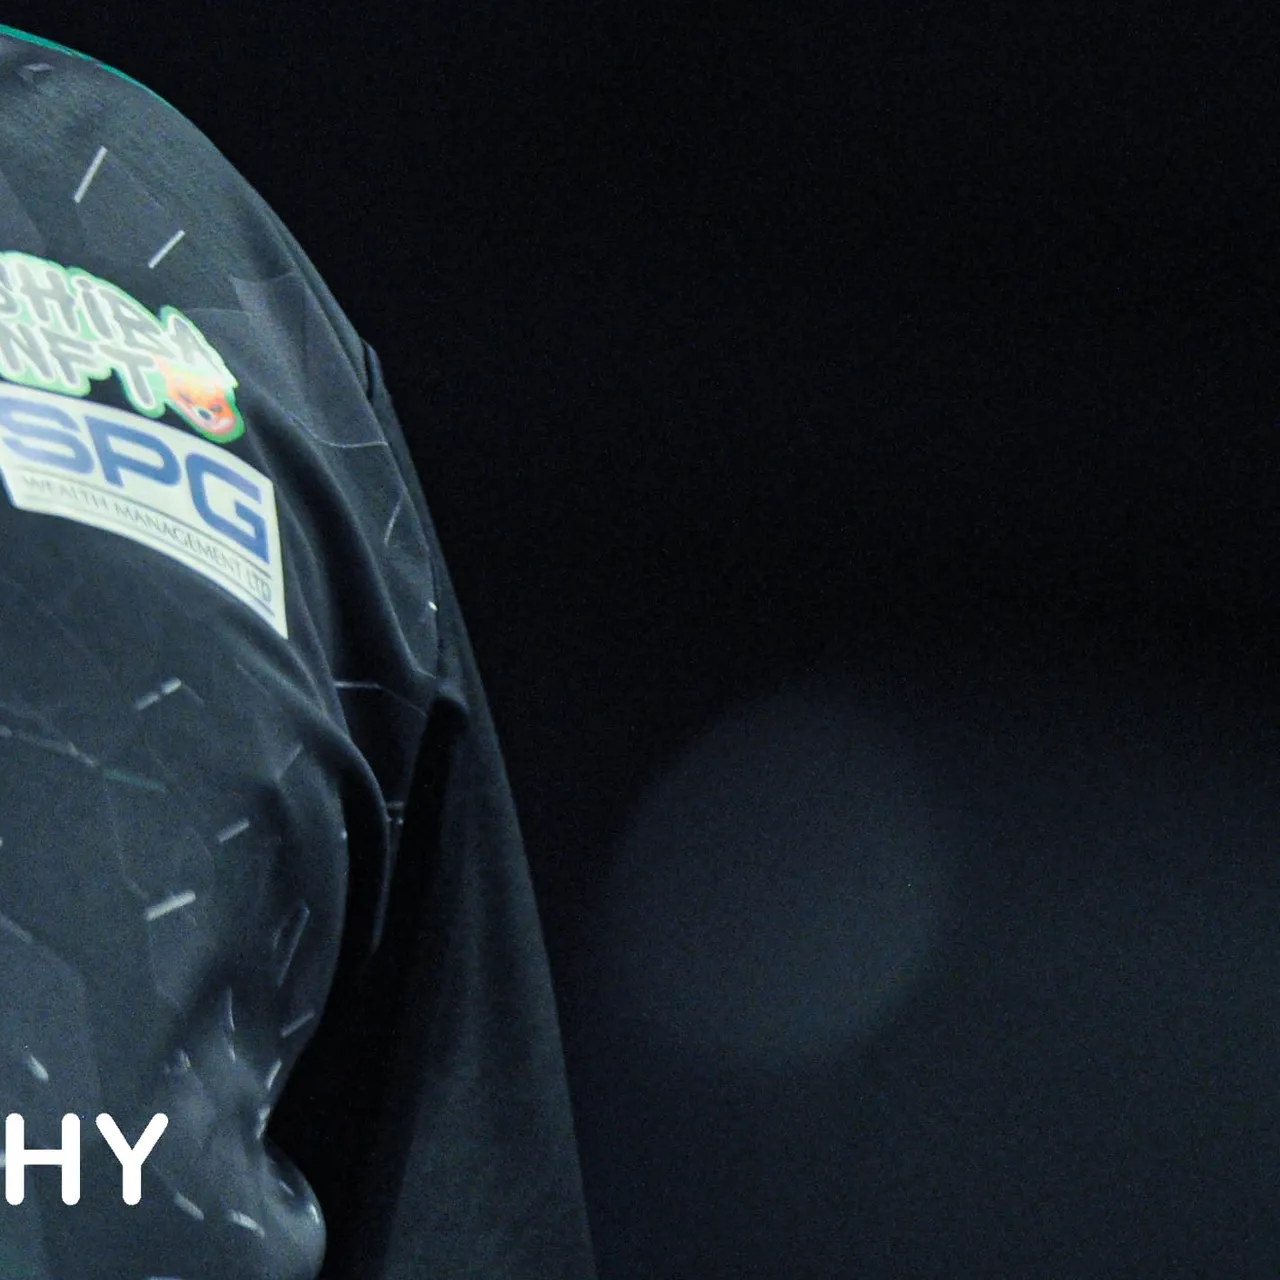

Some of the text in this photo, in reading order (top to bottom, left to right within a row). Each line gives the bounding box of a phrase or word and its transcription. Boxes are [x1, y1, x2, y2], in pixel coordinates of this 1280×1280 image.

[22, 474, 274, 605] WEALTH MANAGEMENT LTD
